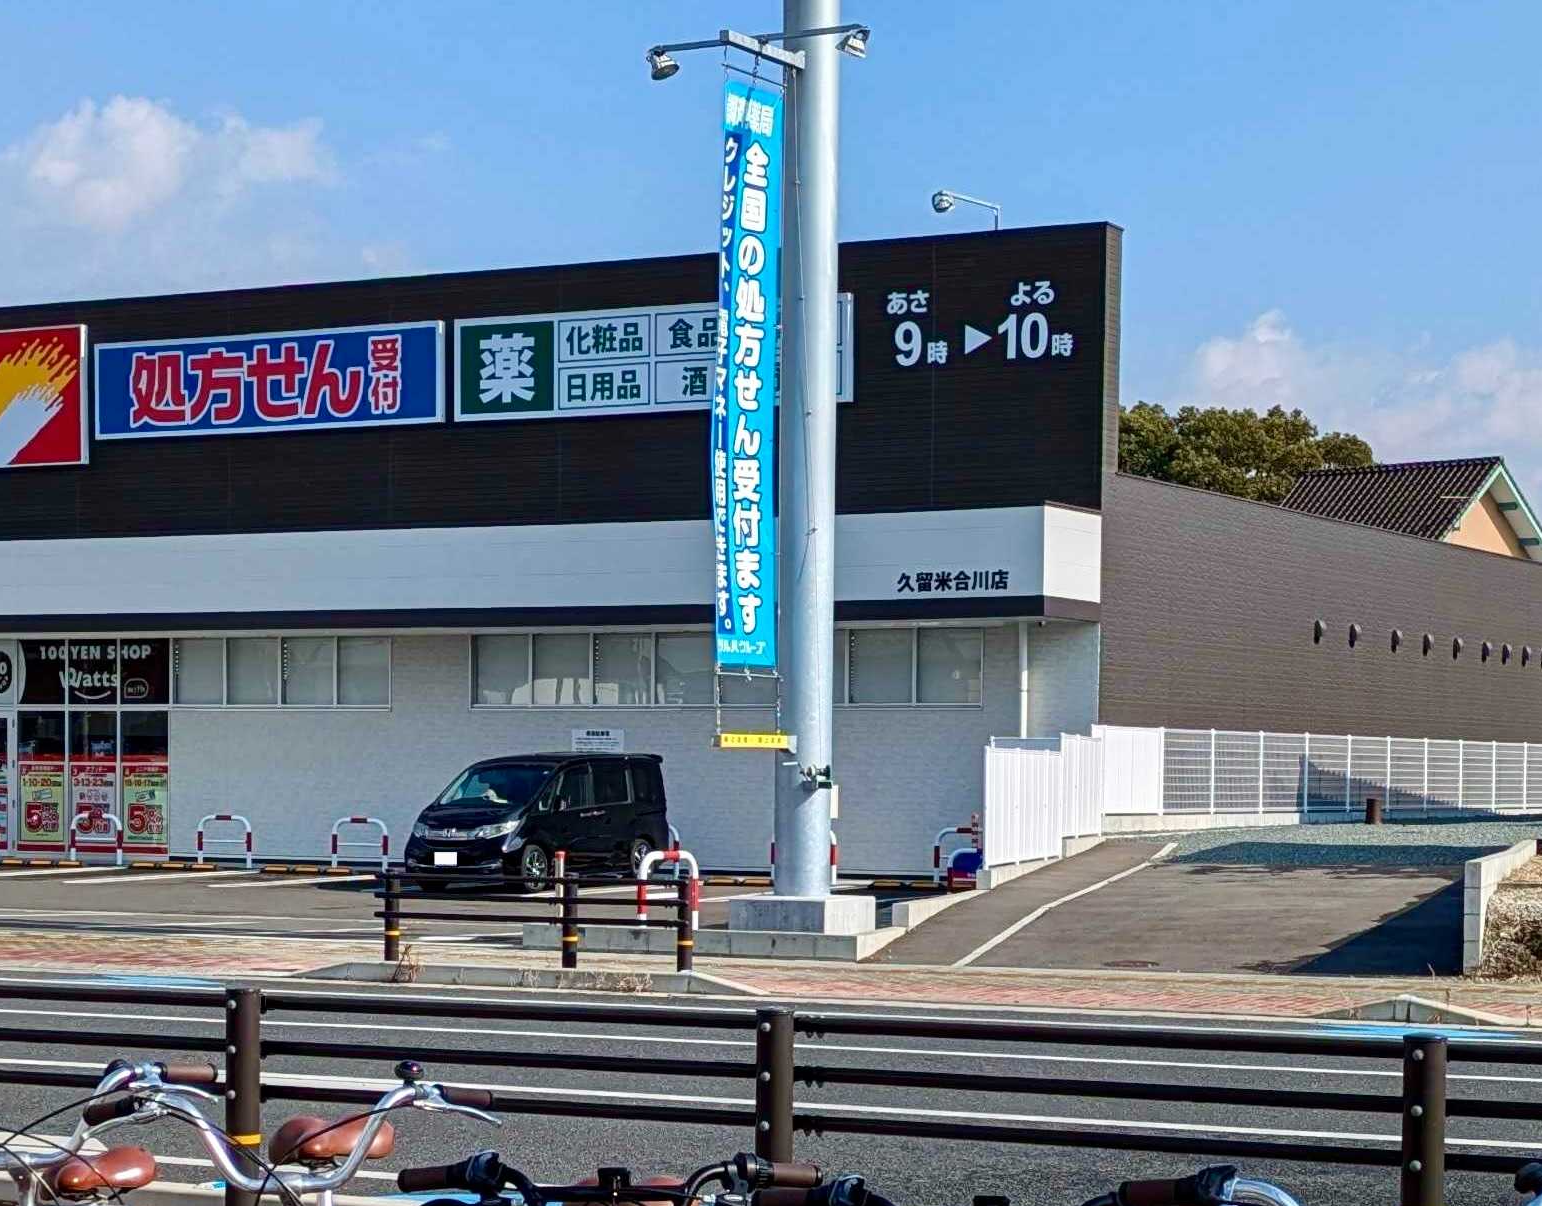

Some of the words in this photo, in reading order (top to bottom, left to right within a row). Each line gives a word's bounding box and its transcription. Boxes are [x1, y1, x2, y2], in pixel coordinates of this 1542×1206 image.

[886, 290, 930, 315] あさ
[1010, 280, 1055, 306] よる
[566, 321, 644, 355] 化粧品
[894, 321, 948, 367] 9時
[997, 312, 1074, 360] 10時
[130, 340, 364, 428] 処方せん
[369, 334, 402, 413] 受付
[479, 333, 535, 404] 薬
[681, 366, 708, 397] 酒
[566, 369, 642, 402] 日用品
[733, 142, 770, 634] 全国の処方せん受付ます
[897, 569, 1009, 593] 久留米合川店
[69, 645, 101, 660] YEN
[59, 667, 119, 689] Watts
